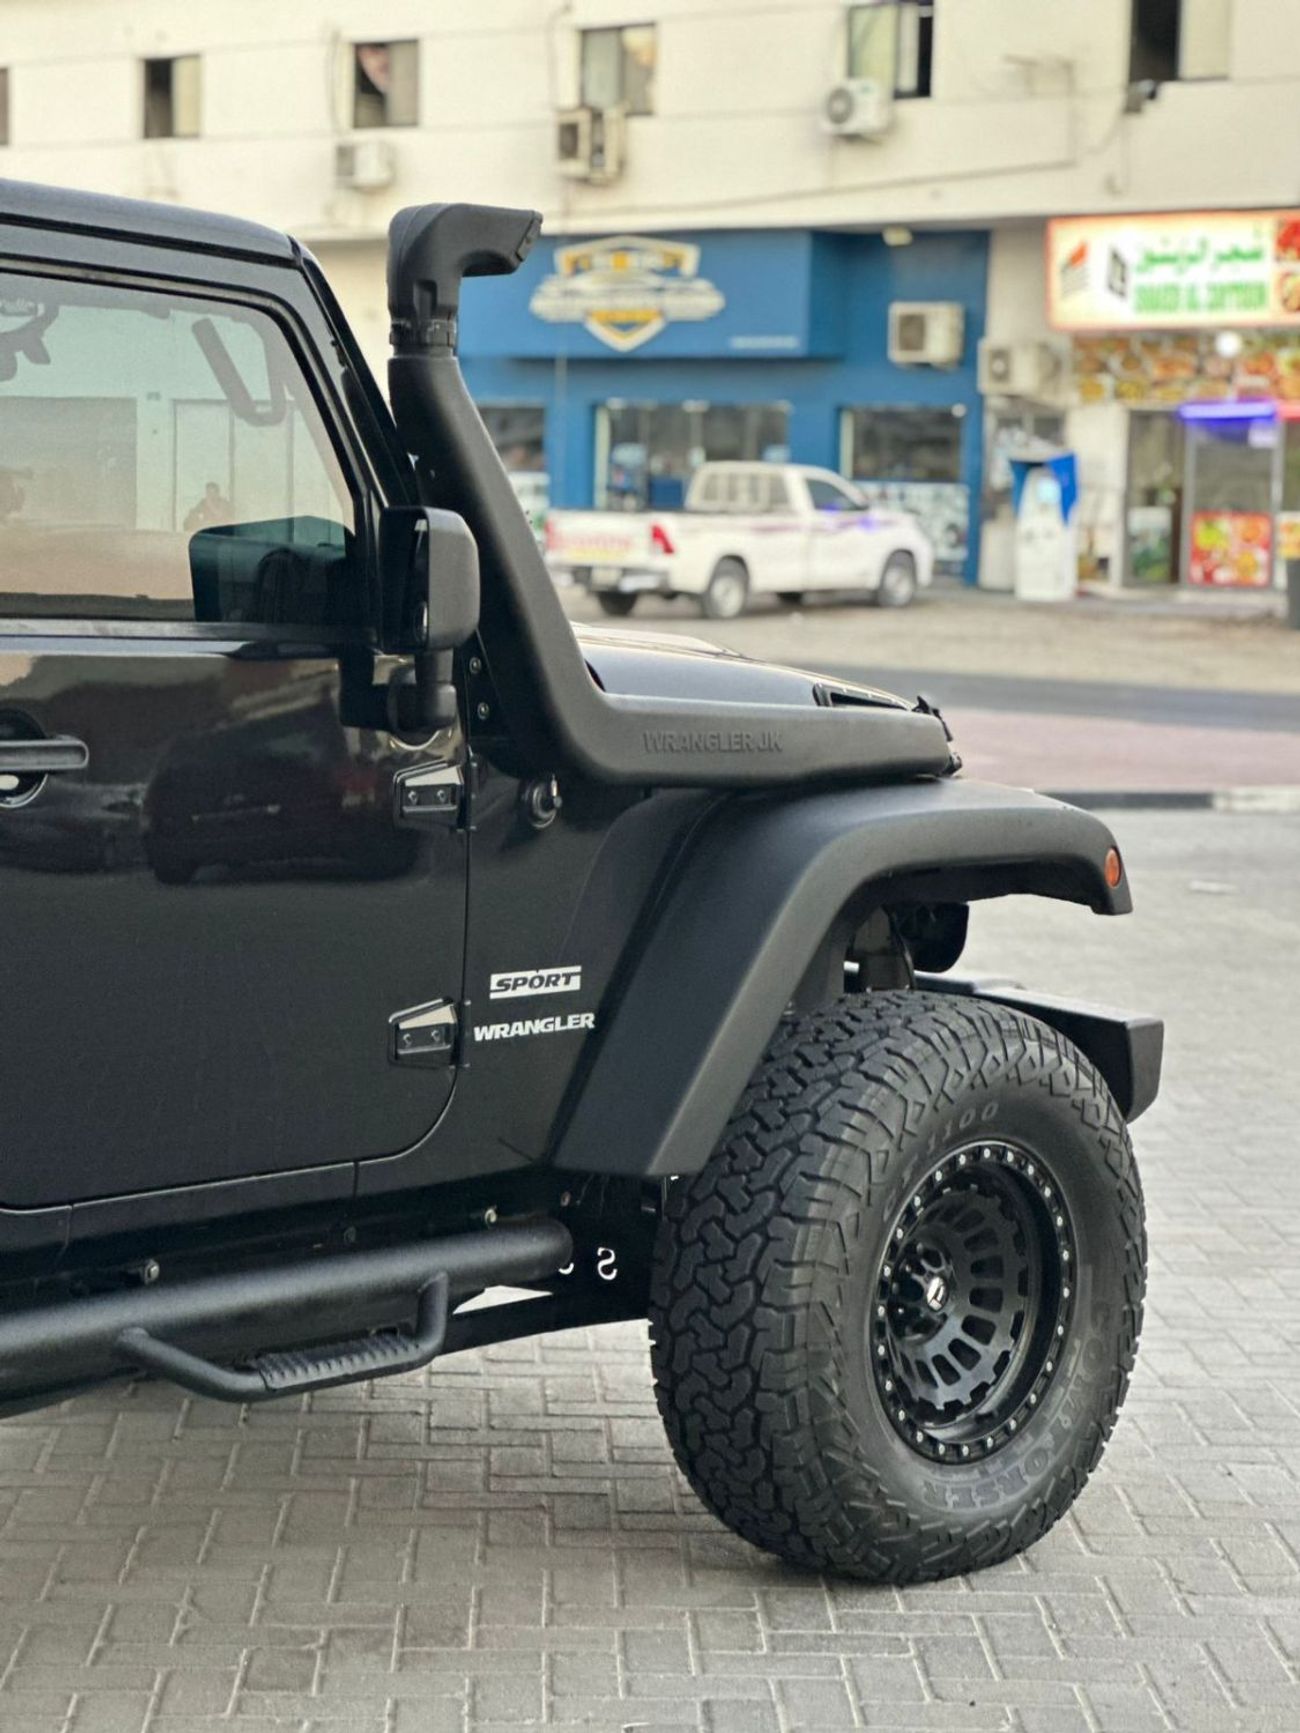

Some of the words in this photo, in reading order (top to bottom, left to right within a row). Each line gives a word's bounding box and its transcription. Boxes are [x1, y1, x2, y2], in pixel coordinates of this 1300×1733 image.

[643, 730, 754, 753] WRANGLER
[757, 730, 783, 753] JK
[493, 970, 582, 993] SPORT
[473, 1012, 595, 1042] WRANGLER
